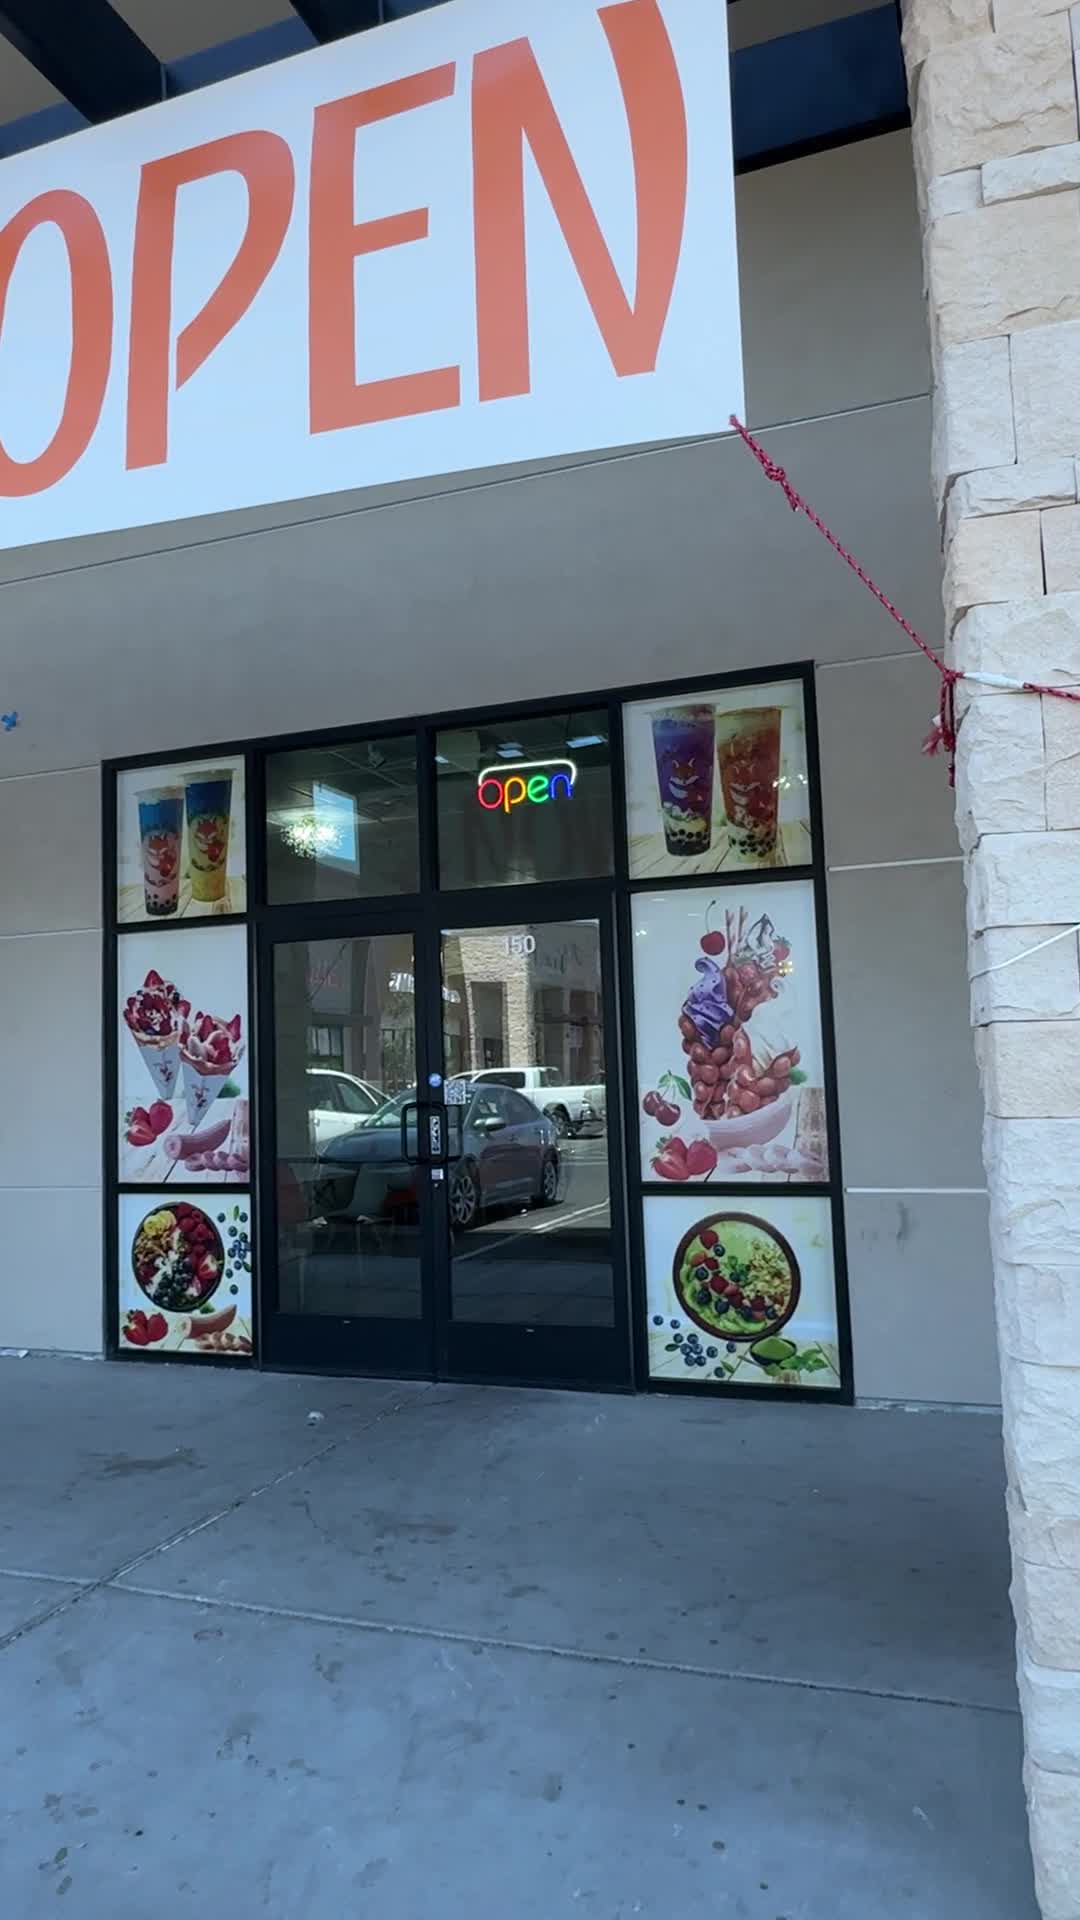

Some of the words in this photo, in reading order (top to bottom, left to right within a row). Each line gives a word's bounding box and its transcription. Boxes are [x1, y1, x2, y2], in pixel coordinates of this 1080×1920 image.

[0, 0, 688, 497] OPEN
[478, 774, 573, 813] open
[504, 935, 536, 953] 150
